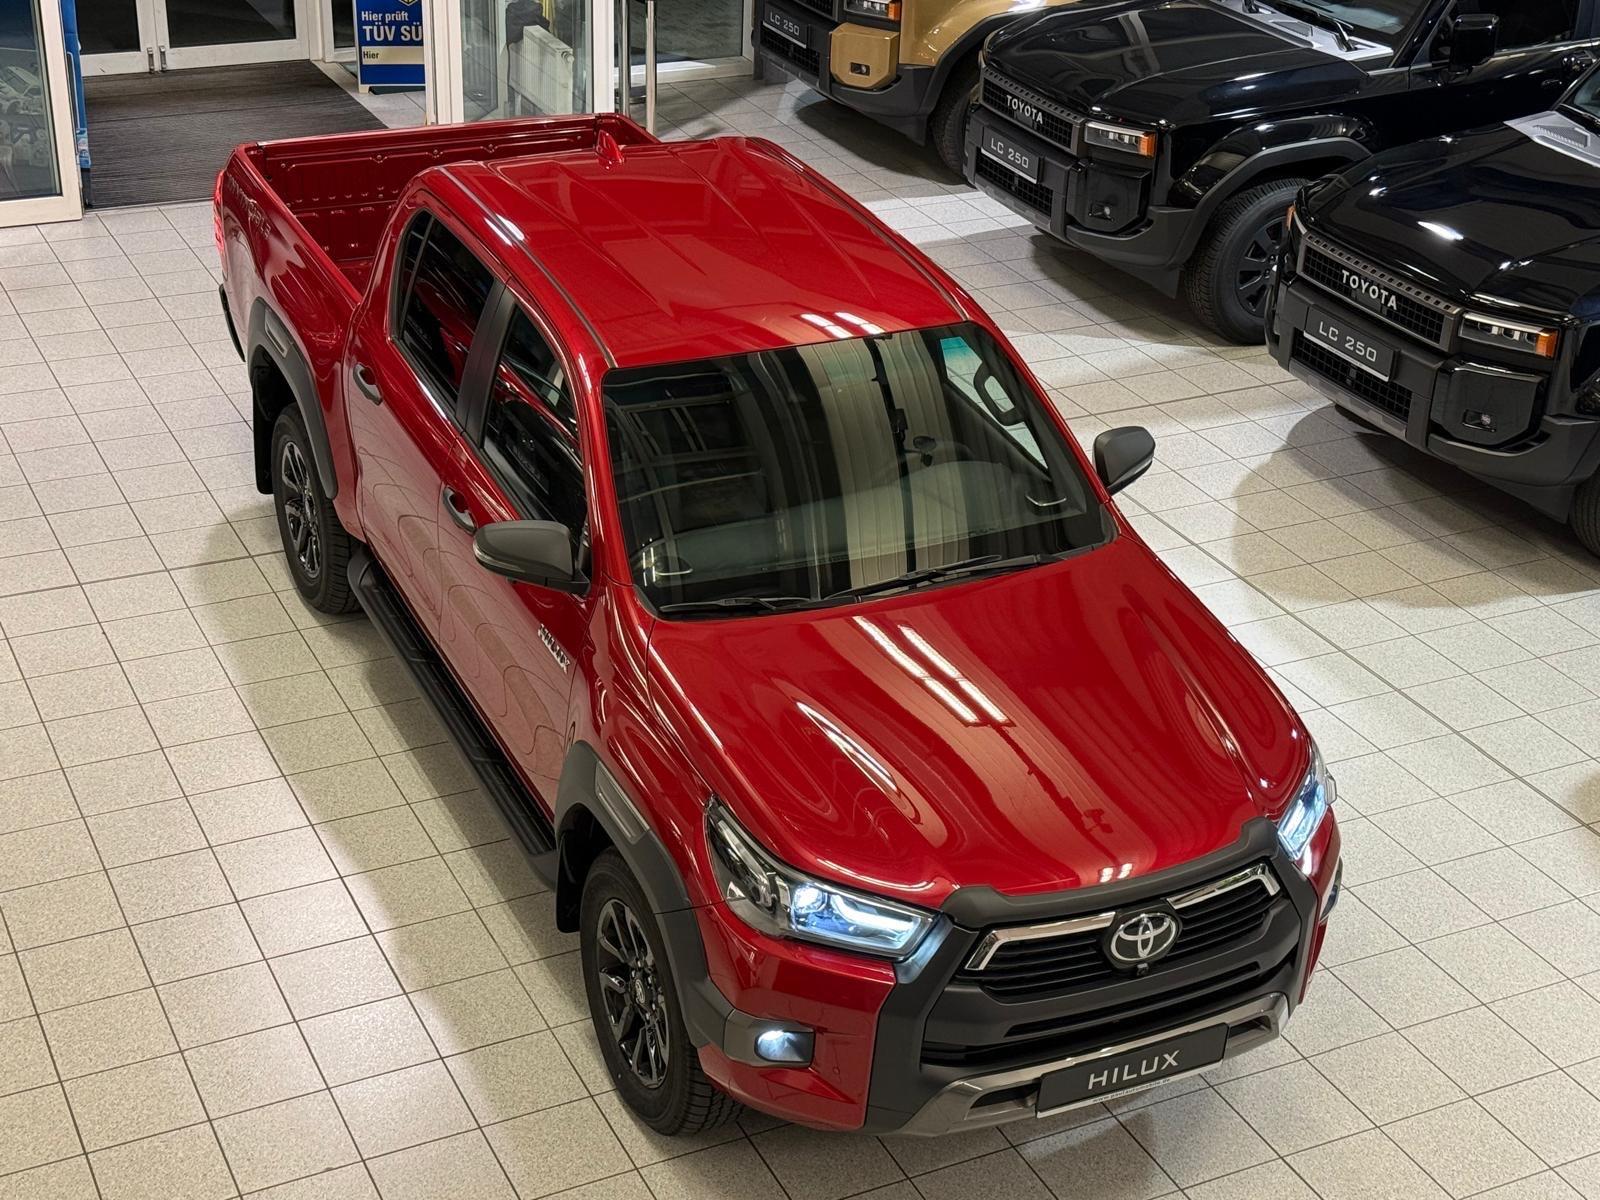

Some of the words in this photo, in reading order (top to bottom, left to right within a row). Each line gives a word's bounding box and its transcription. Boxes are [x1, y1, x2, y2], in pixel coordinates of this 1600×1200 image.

[361, 11, 382, 21] Hier
[385, 11, 409, 23] prüft
[362, 22, 396, 41] TÜV
[770, 10, 781, 26] LC
[783, 19, 800, 36] 250
[362, 50, 380, 60] Hier
[1006, 94, 1043, 125] TOYOTA
[990, 137, 1004, 155] LC
[1007, 147, 1029, 169] 250
[1341, 269, 1397, 311] TOYOTA
[1319, 321, 1339, 342] LC
[1344, 336, 1377, 362] 250
[537, 623, 571, 675] HILUX
[1087, 1049, 1180, 1090] HILUX
